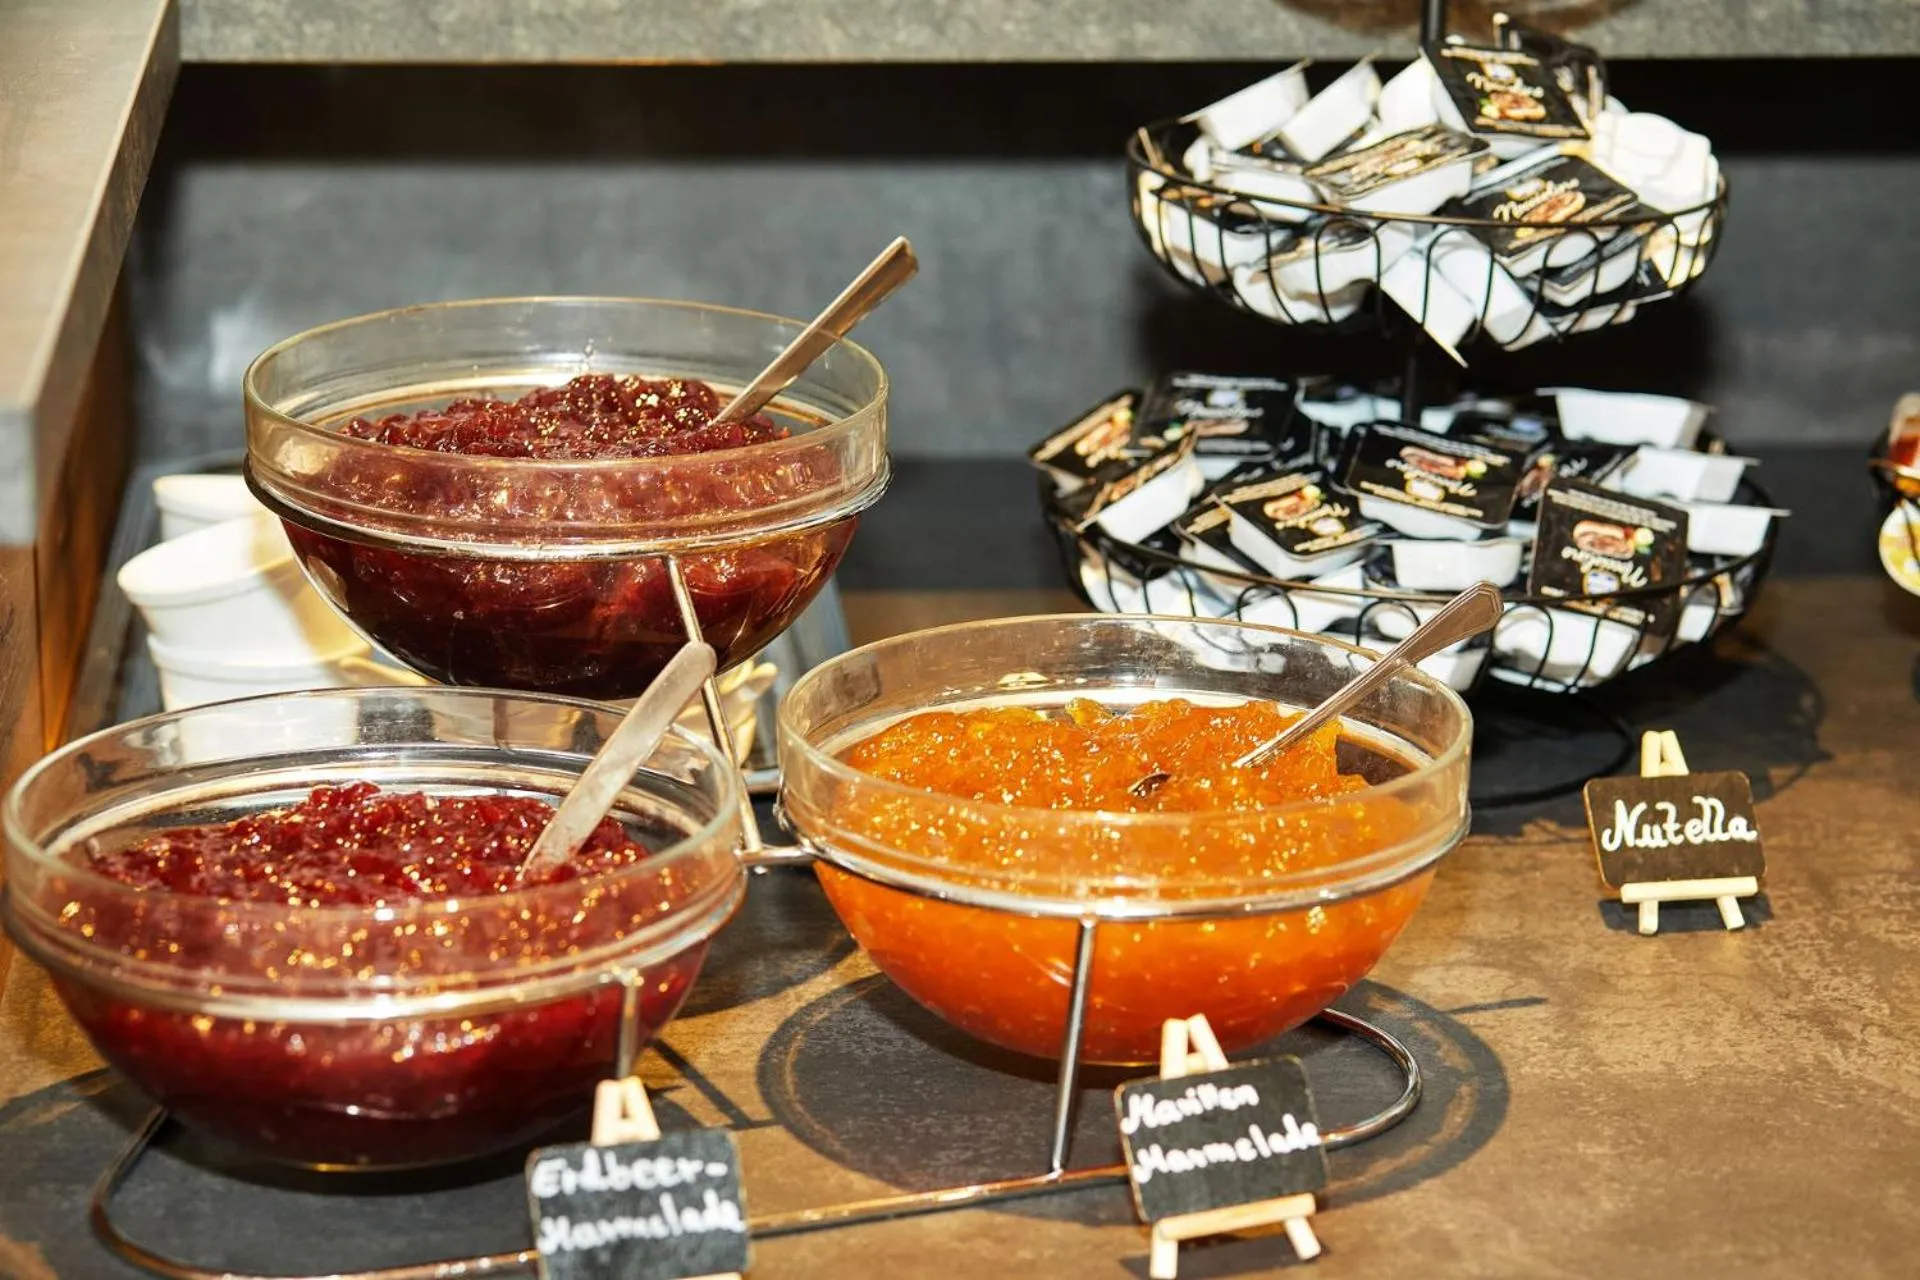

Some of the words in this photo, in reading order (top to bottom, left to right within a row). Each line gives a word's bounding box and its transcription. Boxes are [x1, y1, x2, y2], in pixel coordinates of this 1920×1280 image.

[1601, 795, 1758, 852] Nutella
[530, 1148, 728, 1199] Erdbeer-
[1131, 1113, 1322, 1184] Marmelade
[537, 1188, 746, 1256] Marmelade
